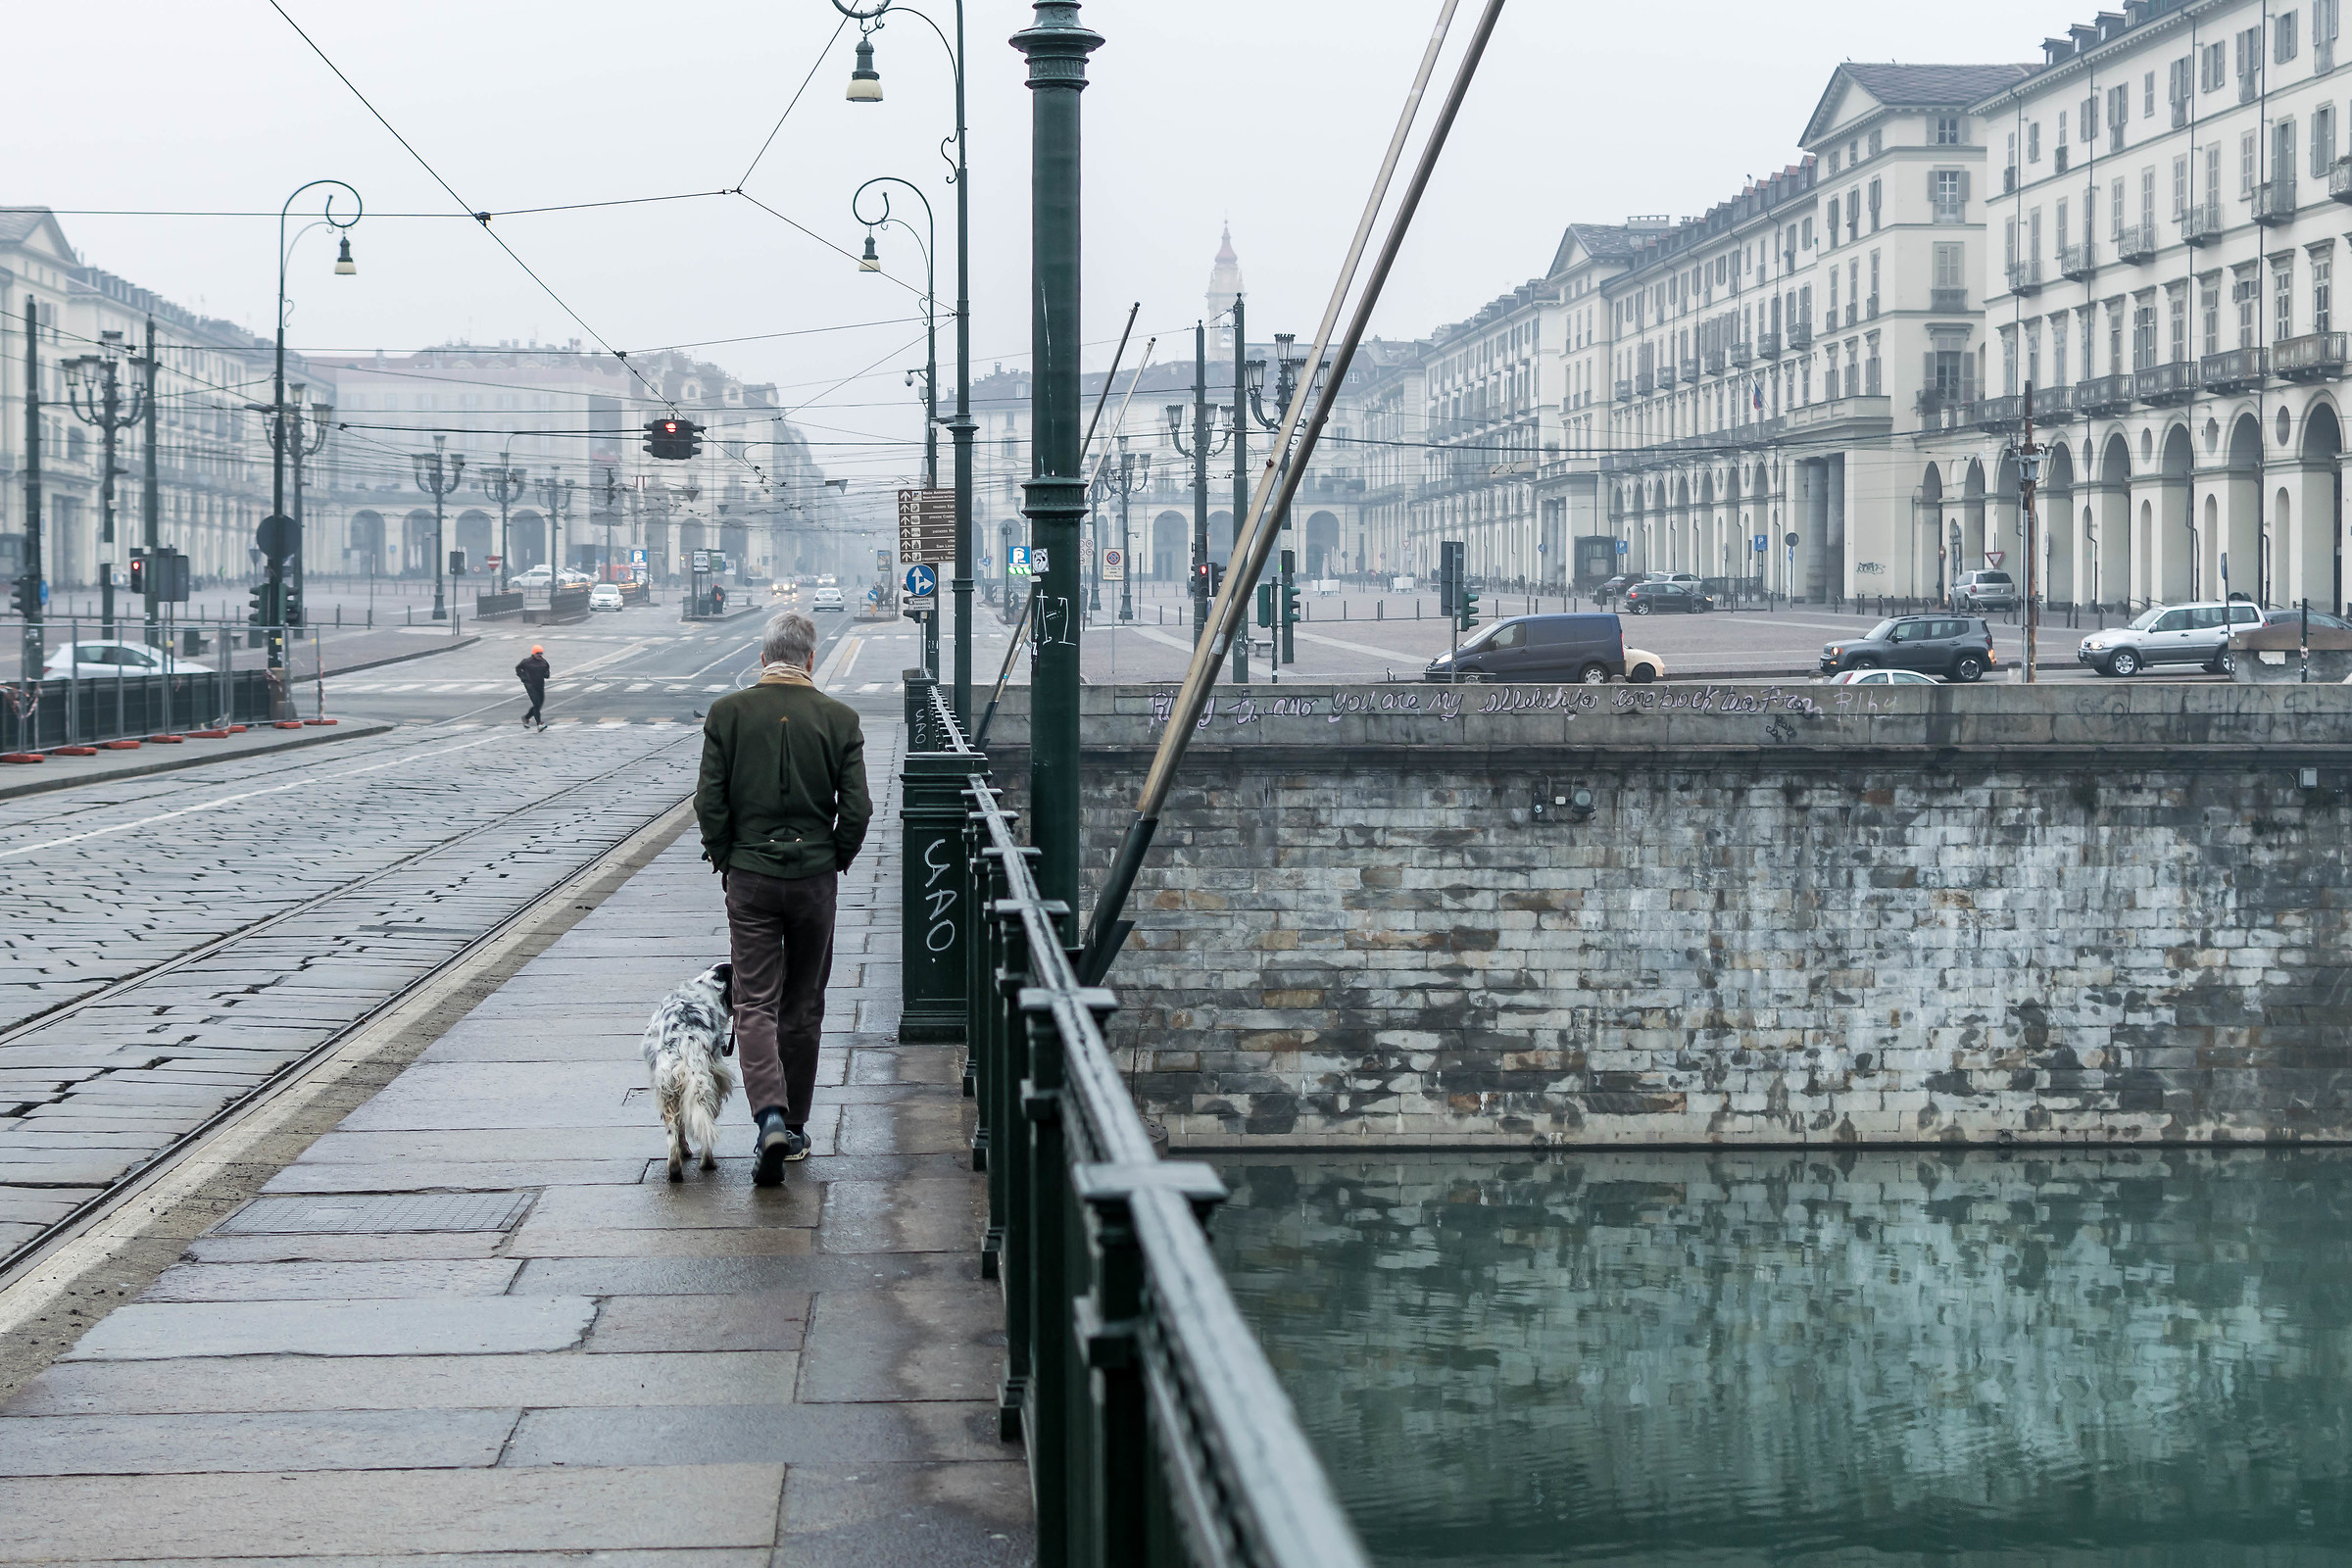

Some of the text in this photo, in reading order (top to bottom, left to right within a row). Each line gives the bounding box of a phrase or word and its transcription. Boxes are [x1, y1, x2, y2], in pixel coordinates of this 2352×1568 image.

[1264, 695, 1320, 717] amo
[1328, 691, 1376, 723] you
[1379, 691, 1421, 711] are
[1426, 691, 1464, 722] my
